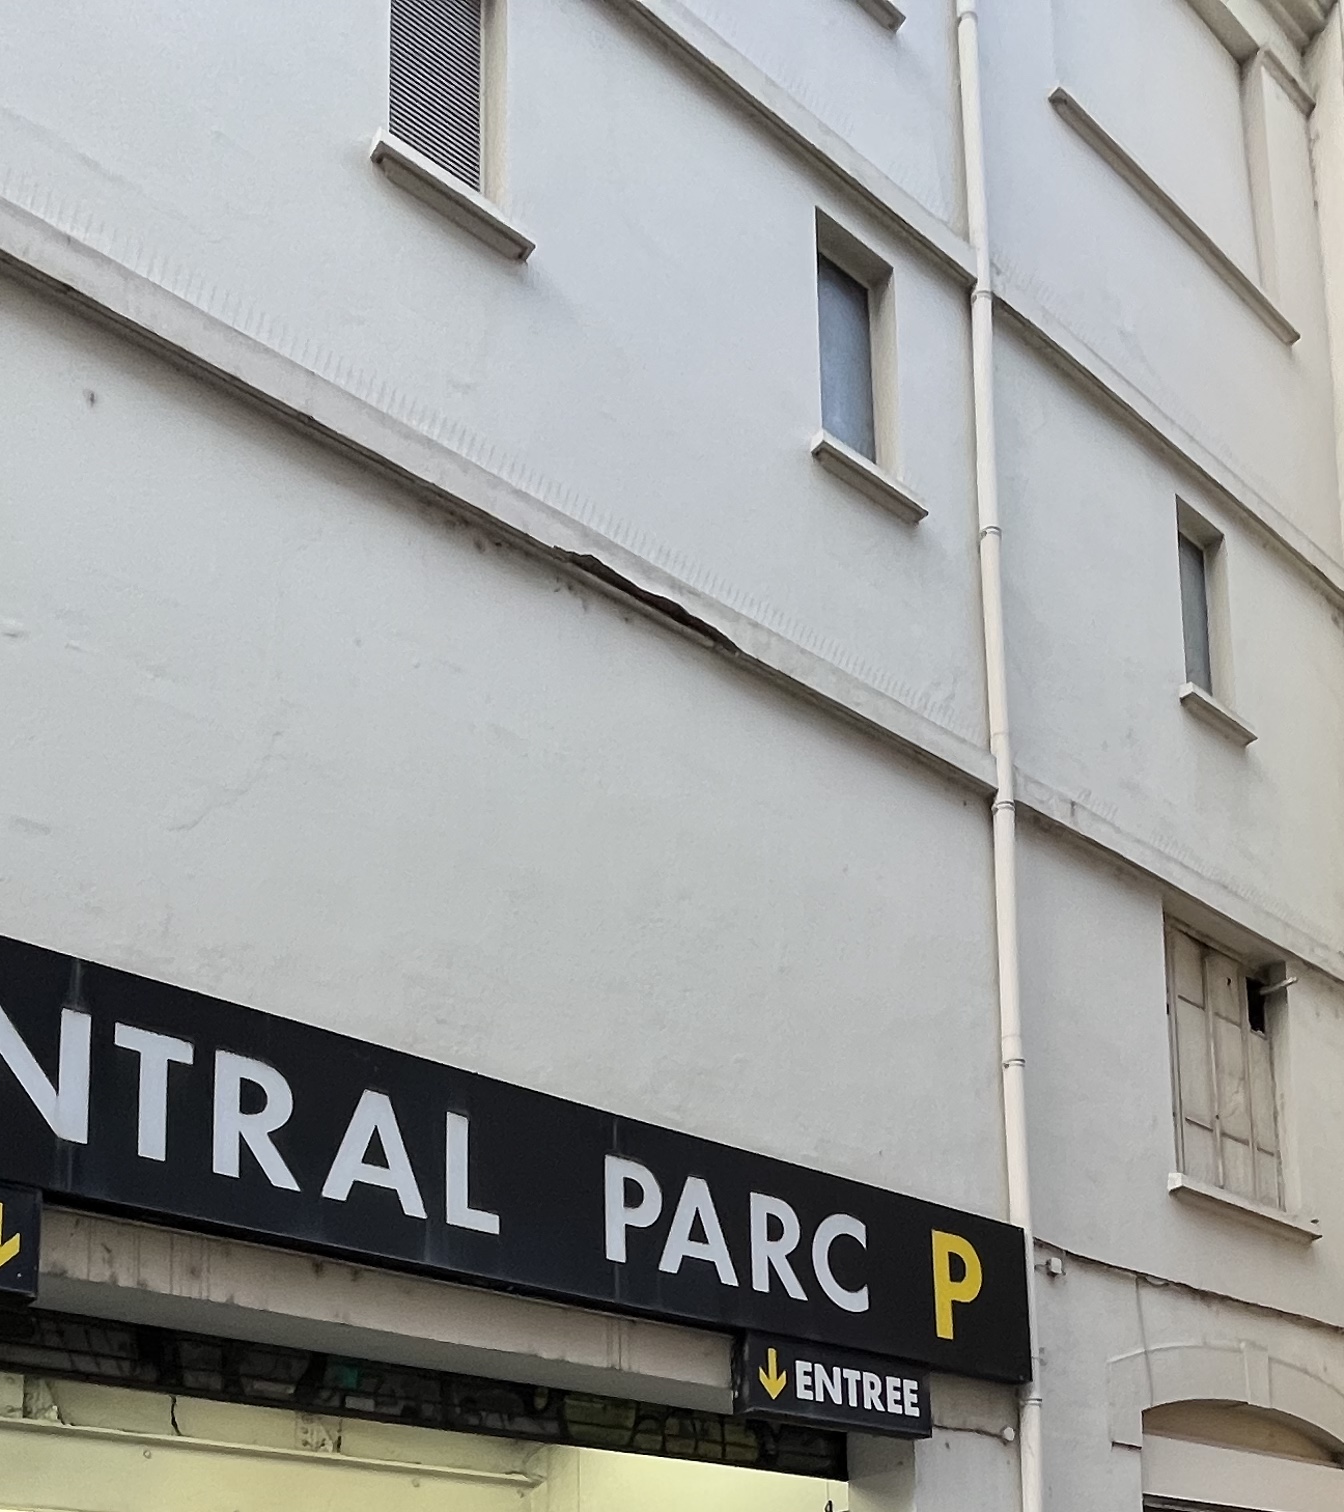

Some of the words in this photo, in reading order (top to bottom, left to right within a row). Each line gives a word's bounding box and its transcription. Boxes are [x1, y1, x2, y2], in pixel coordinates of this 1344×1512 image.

[604, 1154, 870, 1313] PARC
[931, 1229, 983, 1340] P
[794, 1360, 921, 1418] ENTREE
